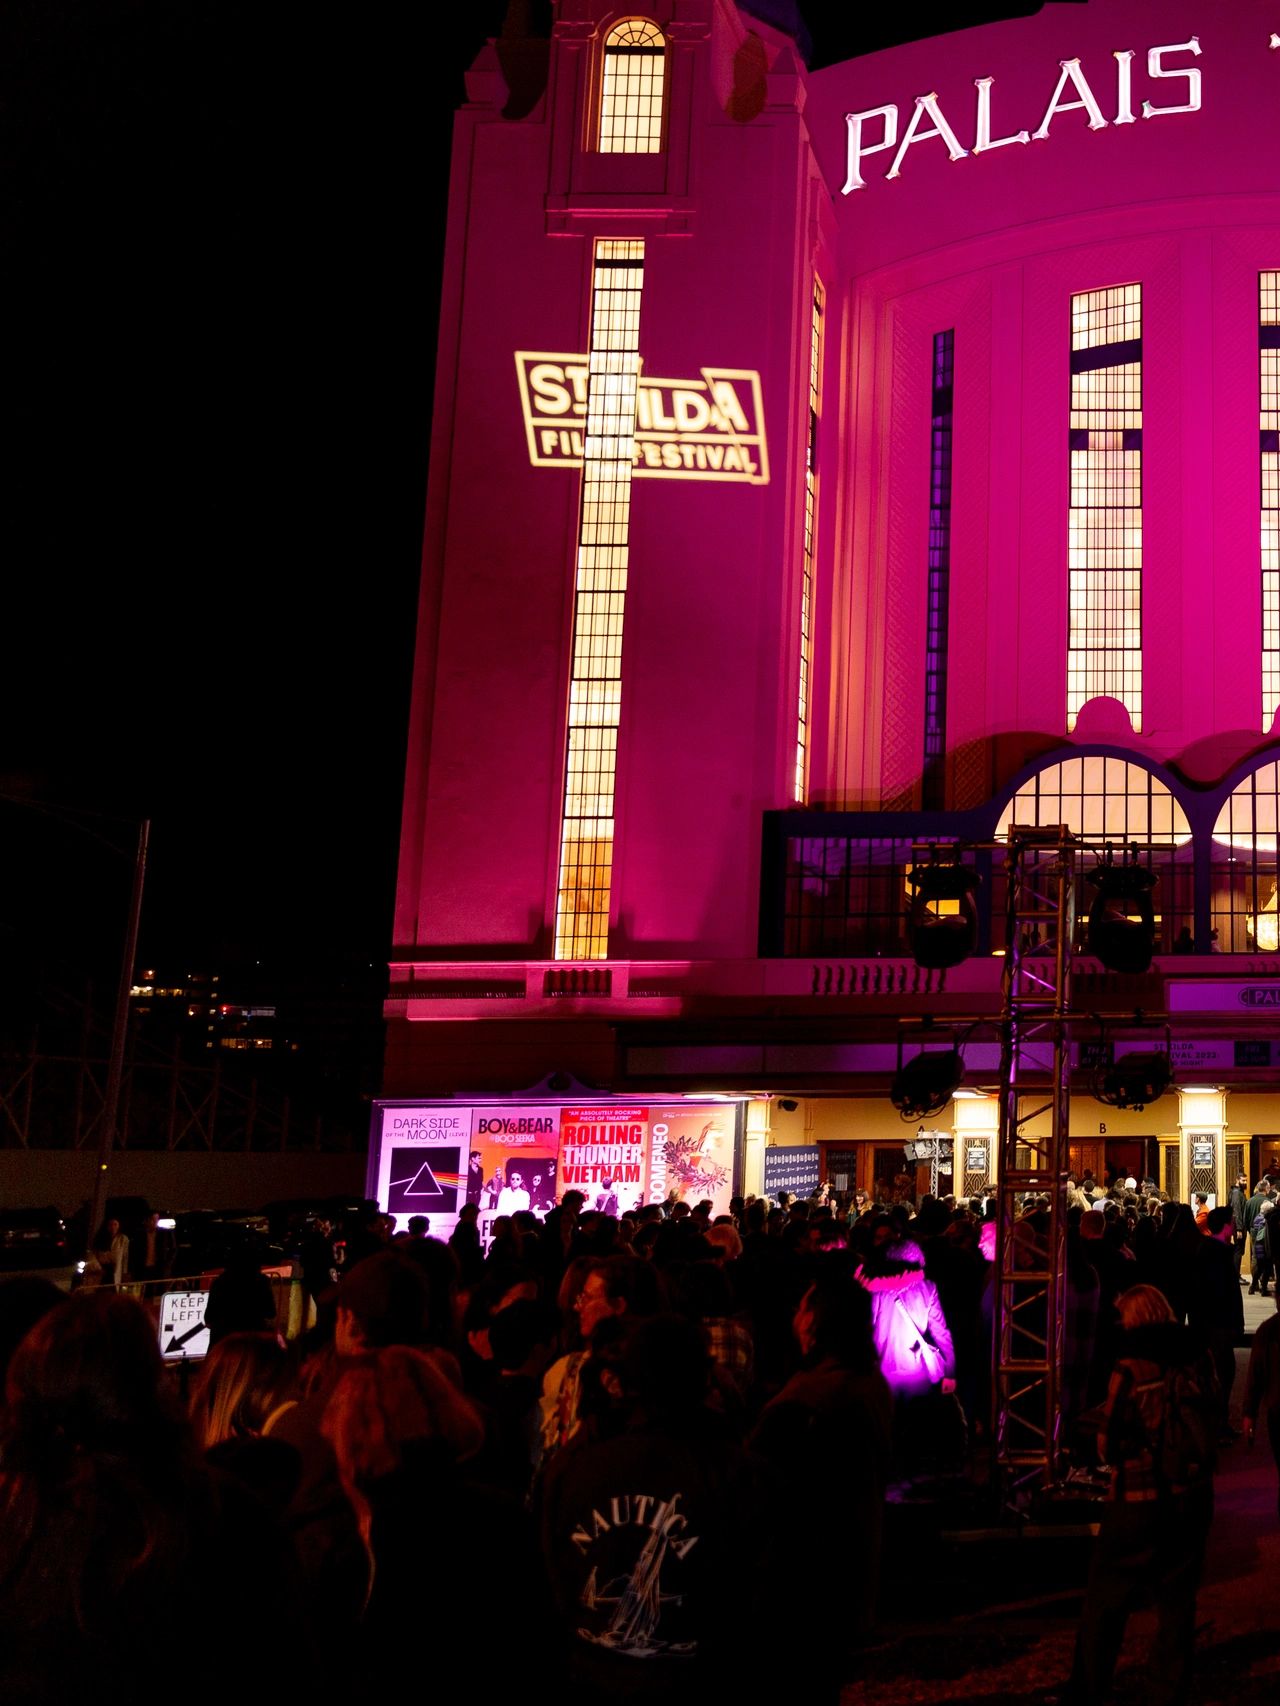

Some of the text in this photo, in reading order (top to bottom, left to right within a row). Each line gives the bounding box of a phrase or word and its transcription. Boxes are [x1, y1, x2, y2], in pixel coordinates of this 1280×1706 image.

[841, 35, 1203, 195] PALAIS
[637, 381, 750, 432] ILDA
[540, 430, 585, 456] FIL
[393, 1117, 460, 1129] DARK SIDE
[1099, 1122, 1107, 1134] B
[407, 1129, 448, 1140] MOON
[494, 1135, 515, 1143] BOO
[563, 1124, 642, 1146] ROLLING
[563, 1145, 642, 1165] THUNDER
[649, 1123, 669, 1205] DOMENEO
[562, 1165, 641, 1184] VIETNAM
[171, 1297, 205, 1308] KEEP
[171, 1310, 203, 1321] LEFT
[570, 1494, 700, 1560] NAUTICA
